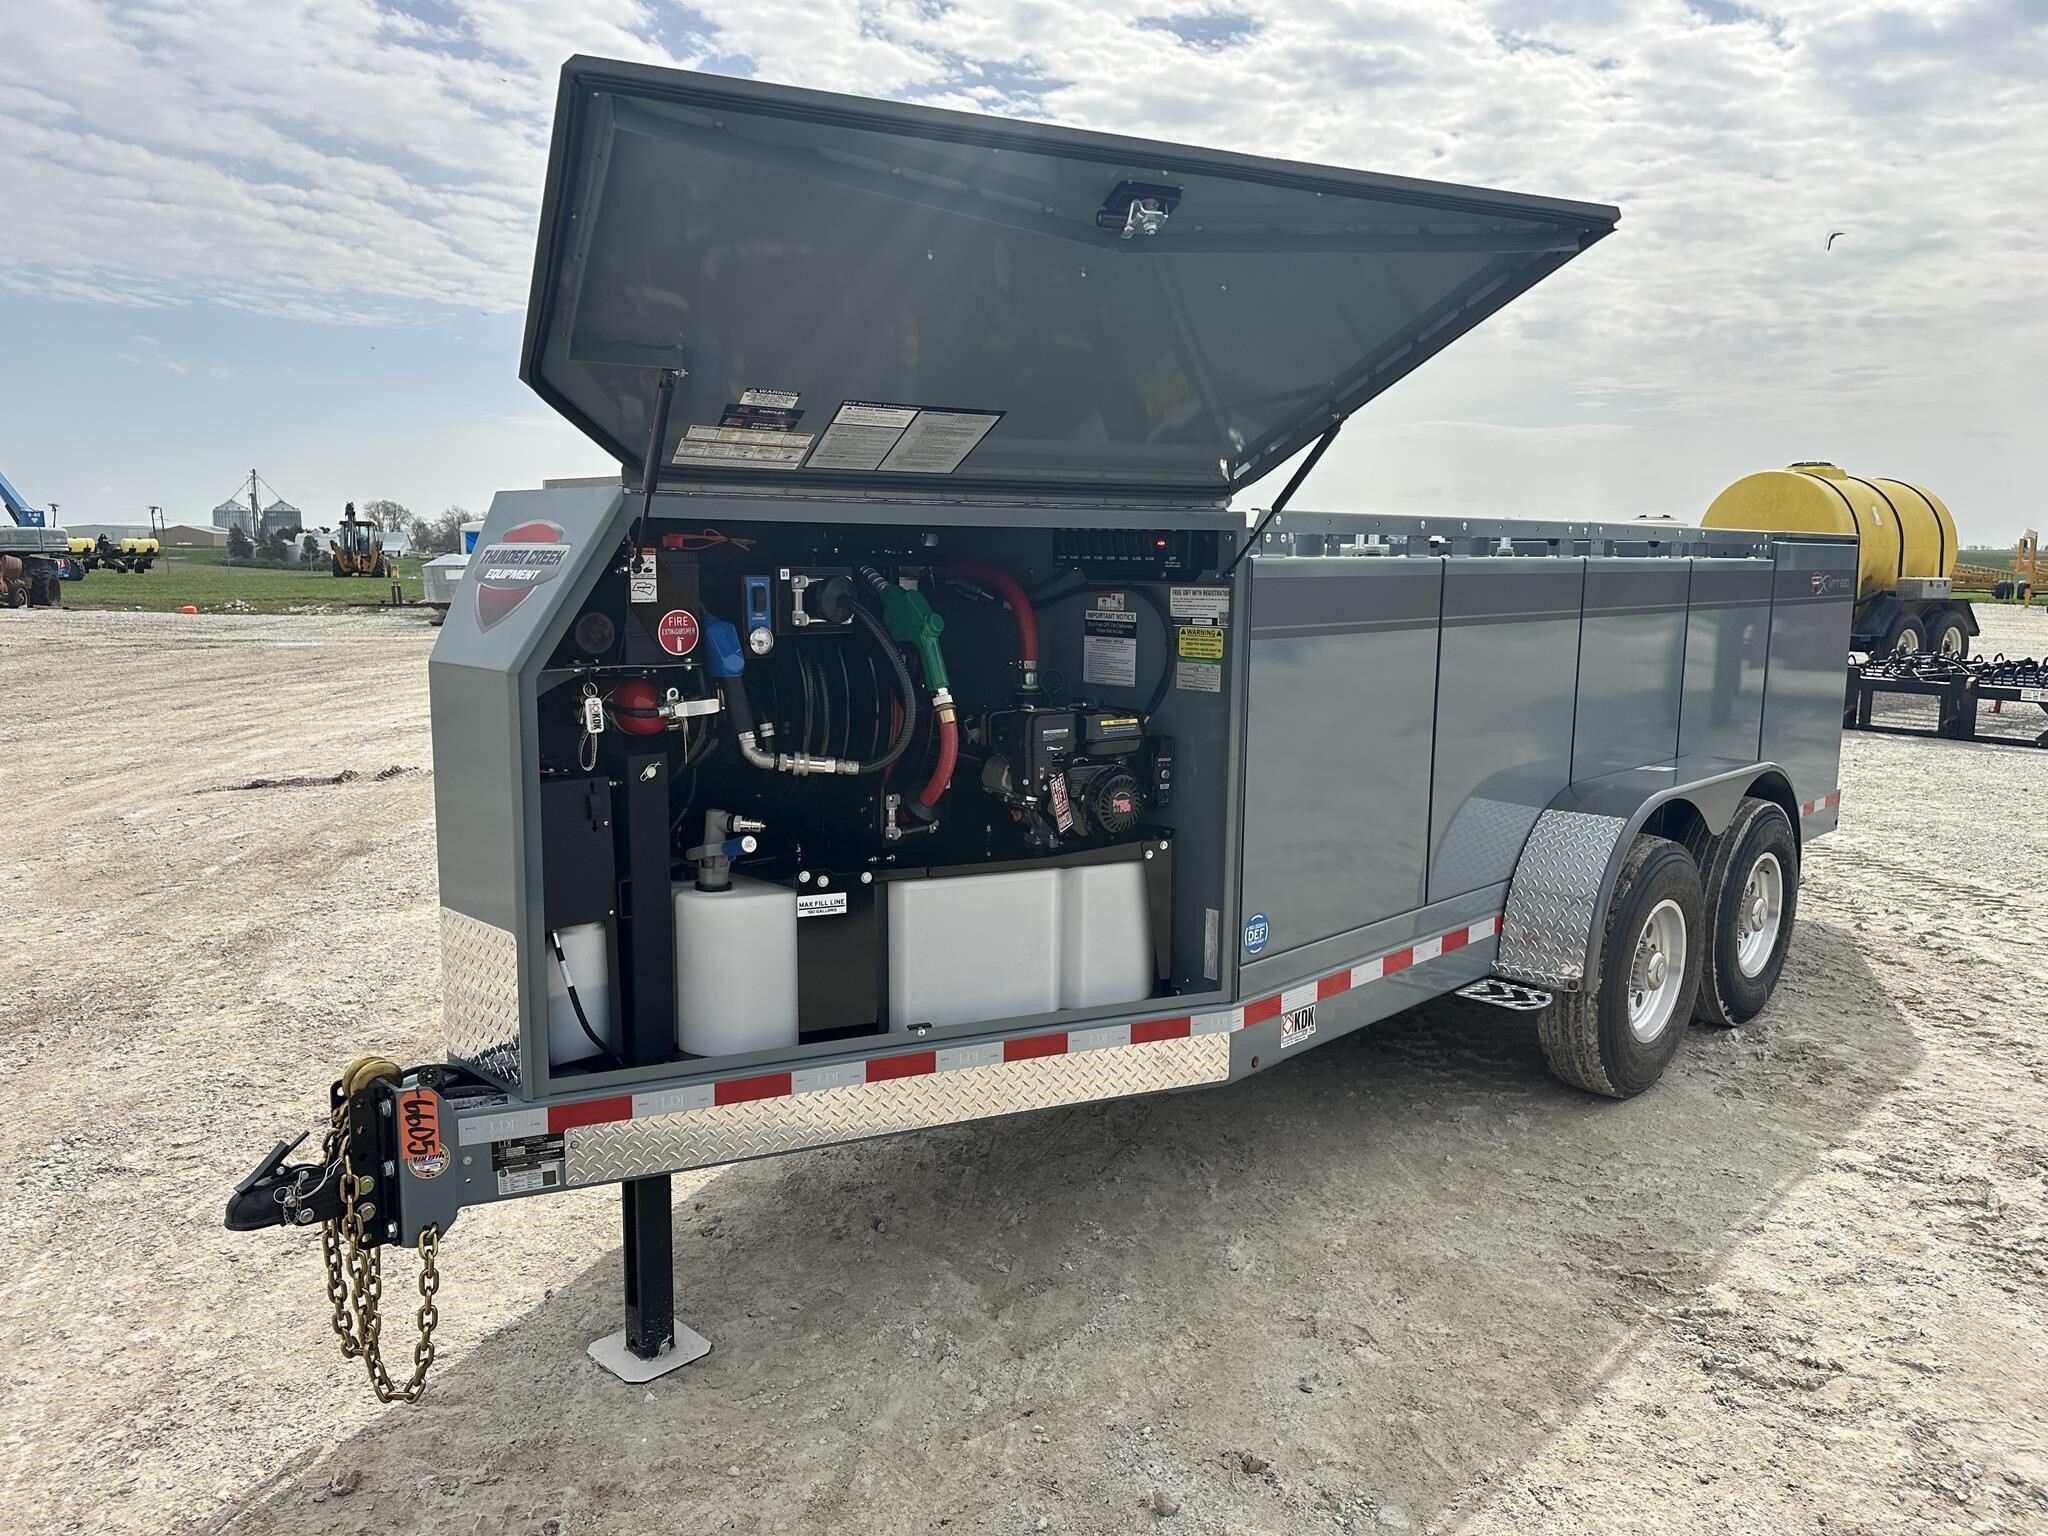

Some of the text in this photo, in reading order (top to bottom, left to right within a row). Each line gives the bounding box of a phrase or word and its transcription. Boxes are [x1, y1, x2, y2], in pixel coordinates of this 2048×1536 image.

[759, 388, 798, 396] WARNING
[883, 403, 922, 411] Instructions
[480, 549, 567, 566] THUNDER CREEK
[484, 568, 542, 580] EQUIPMENT
[668, 616, 688, 627] FIRE
[1087, 611, 1135, 621] IMPORTANT NOTICE
[661, 627, 696, 636] EXTINGUISHER
[1187, 629, 1216, 637] WARNING
[592, 713, 602, 730] KDK
[830, 898, 845, 906] LINE
[1248, 927, 1265, 941] DEF
[1294, 1006, 1315, 1032] KDK
[660, 1095, 686, 1108] LDJ
[403, 1099, 436, 1155] 6605
[488, 1119, 515, 1134] LDJ
